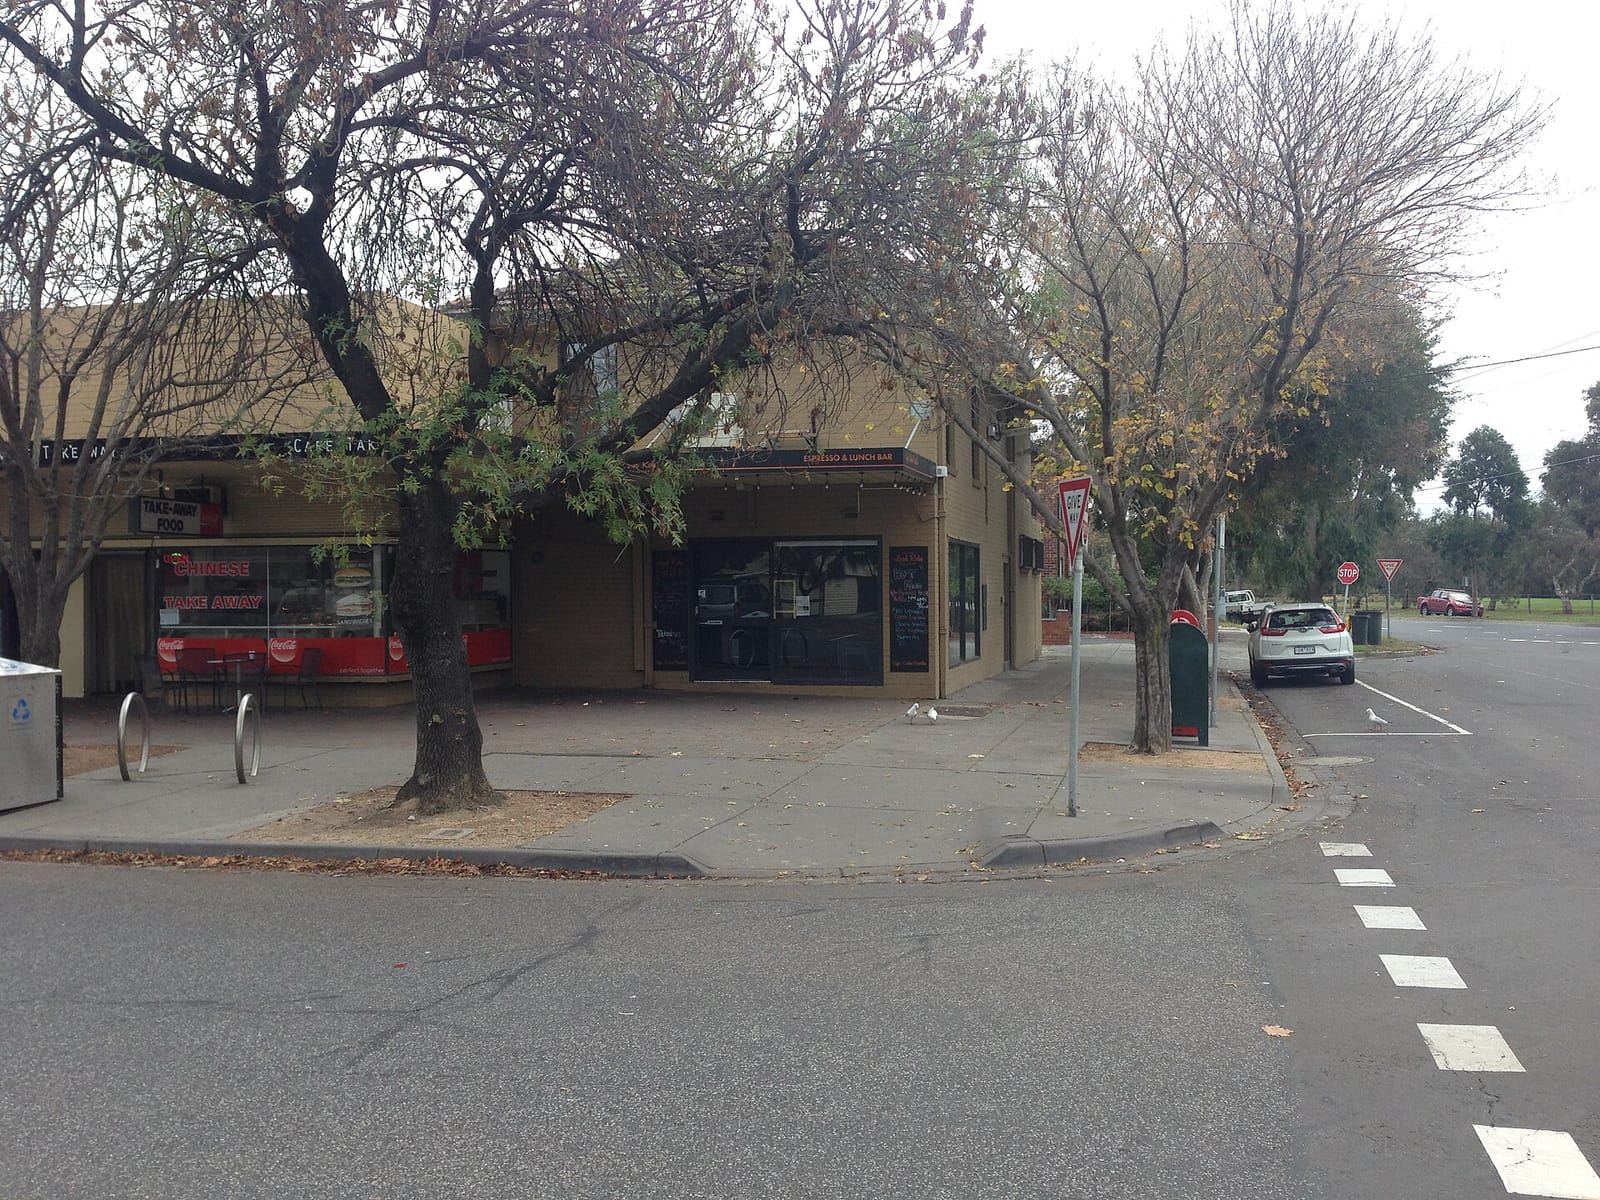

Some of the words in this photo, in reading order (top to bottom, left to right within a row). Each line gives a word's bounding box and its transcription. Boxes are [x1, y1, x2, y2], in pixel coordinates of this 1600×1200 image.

[347, 437, 377, 451] TAK
[42, 445, 79, 459] TKE
[803, 454, 840, 462] ESPRESSO
[849, 453, 875, 461] LUNCH
[143, 501, 198, 517] TAKE-AWAY
[1067, 494, 1082, 510] GIVE
[157, 518, 184, 532] FOOD
[174, 560, 250, 577] CHINESE
[1339, 568, 1357, 578] STOP
[163, 595, 208, 610] TAKE
[211, 595, 262, 610] AWAY
[159, 639, 184, 650] Coca-Cola
[271, 639, 296, 650] Coca-Cola
